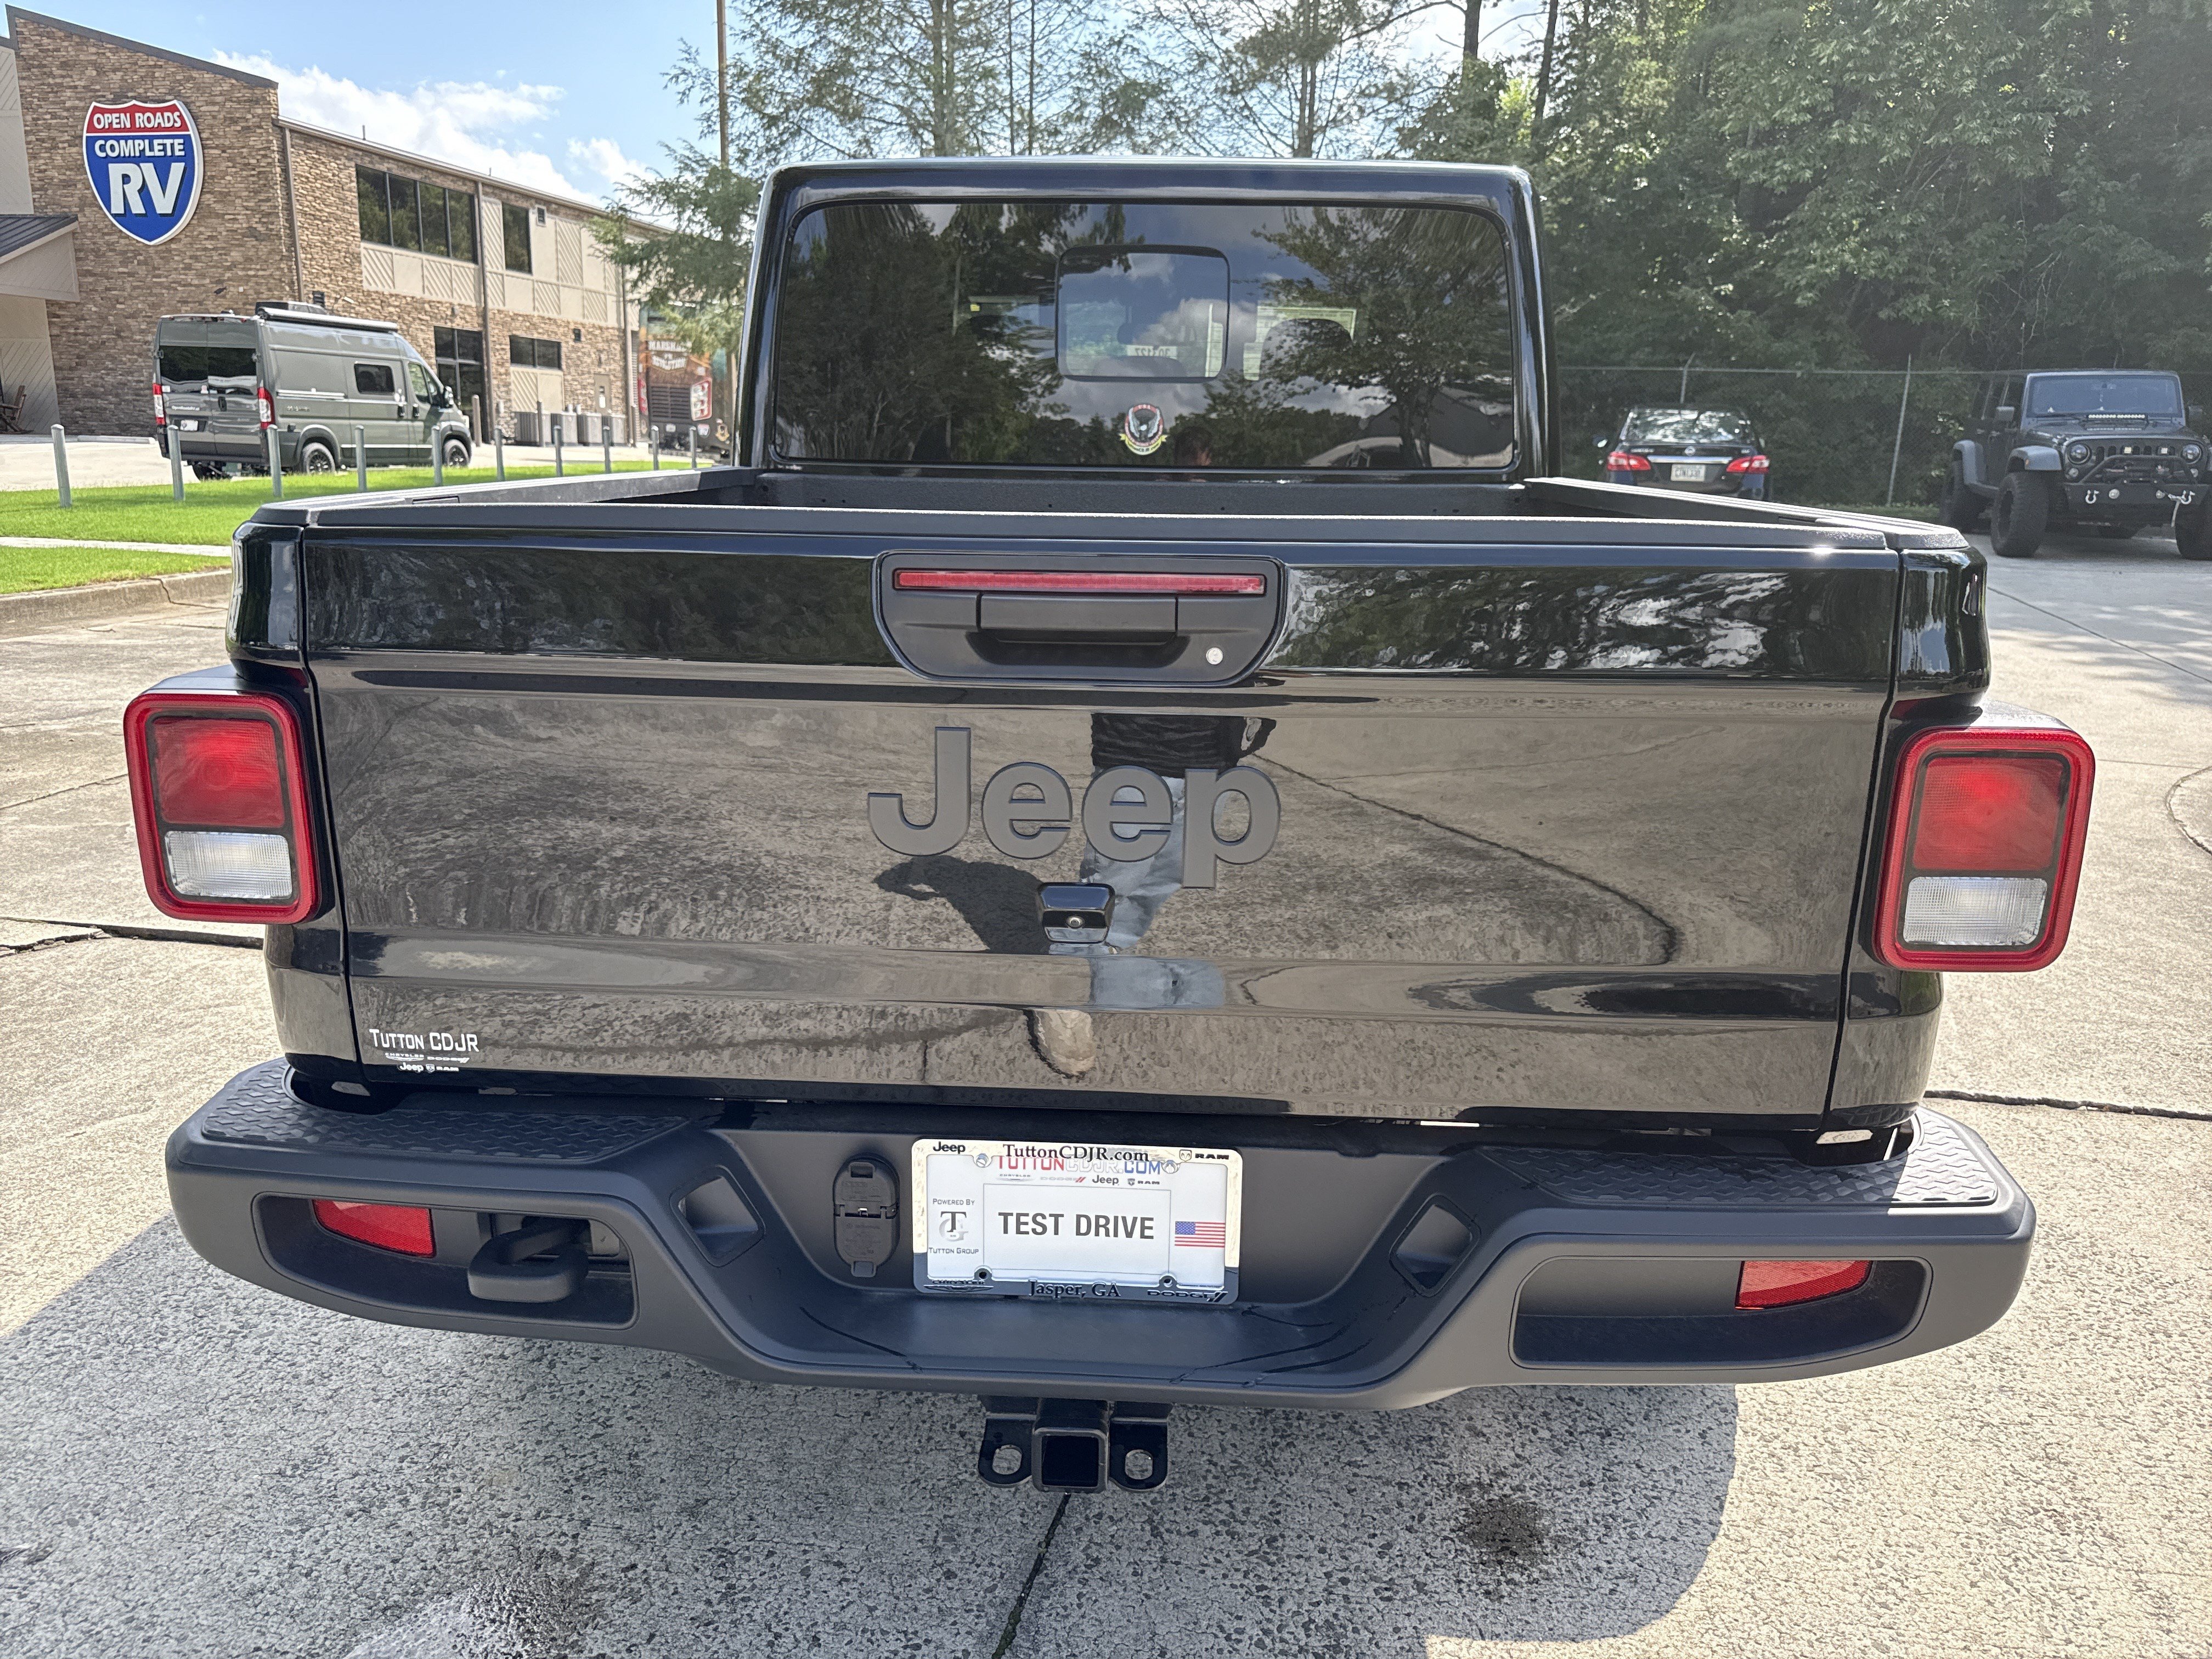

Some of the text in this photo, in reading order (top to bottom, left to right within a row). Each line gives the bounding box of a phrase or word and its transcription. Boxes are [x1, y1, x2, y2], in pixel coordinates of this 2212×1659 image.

[93, 111, 182, 129] OPEN ROADS
[94, 138, 185, 157] COMPLETE
[108, 162, 185, 214] RV
[867, 726, 1281, 889] Jeep
[369, 1029, 479, 1052] TUTTON CDJR
[399, 1062, 424, 1073] Jeep
[933, 1141, 966, 1155] Jeep
[1002, 1143, 1149, 1163] TuttonCDJR.com
[1092, 1175, 1120, 1186] Jeep
[998, 1212, 1154, 1239] TEST DRIVE
[1028, 1278, 1121, 1300] Jasper, GA
[1147, 1289, 1216, 1299] DODGE
